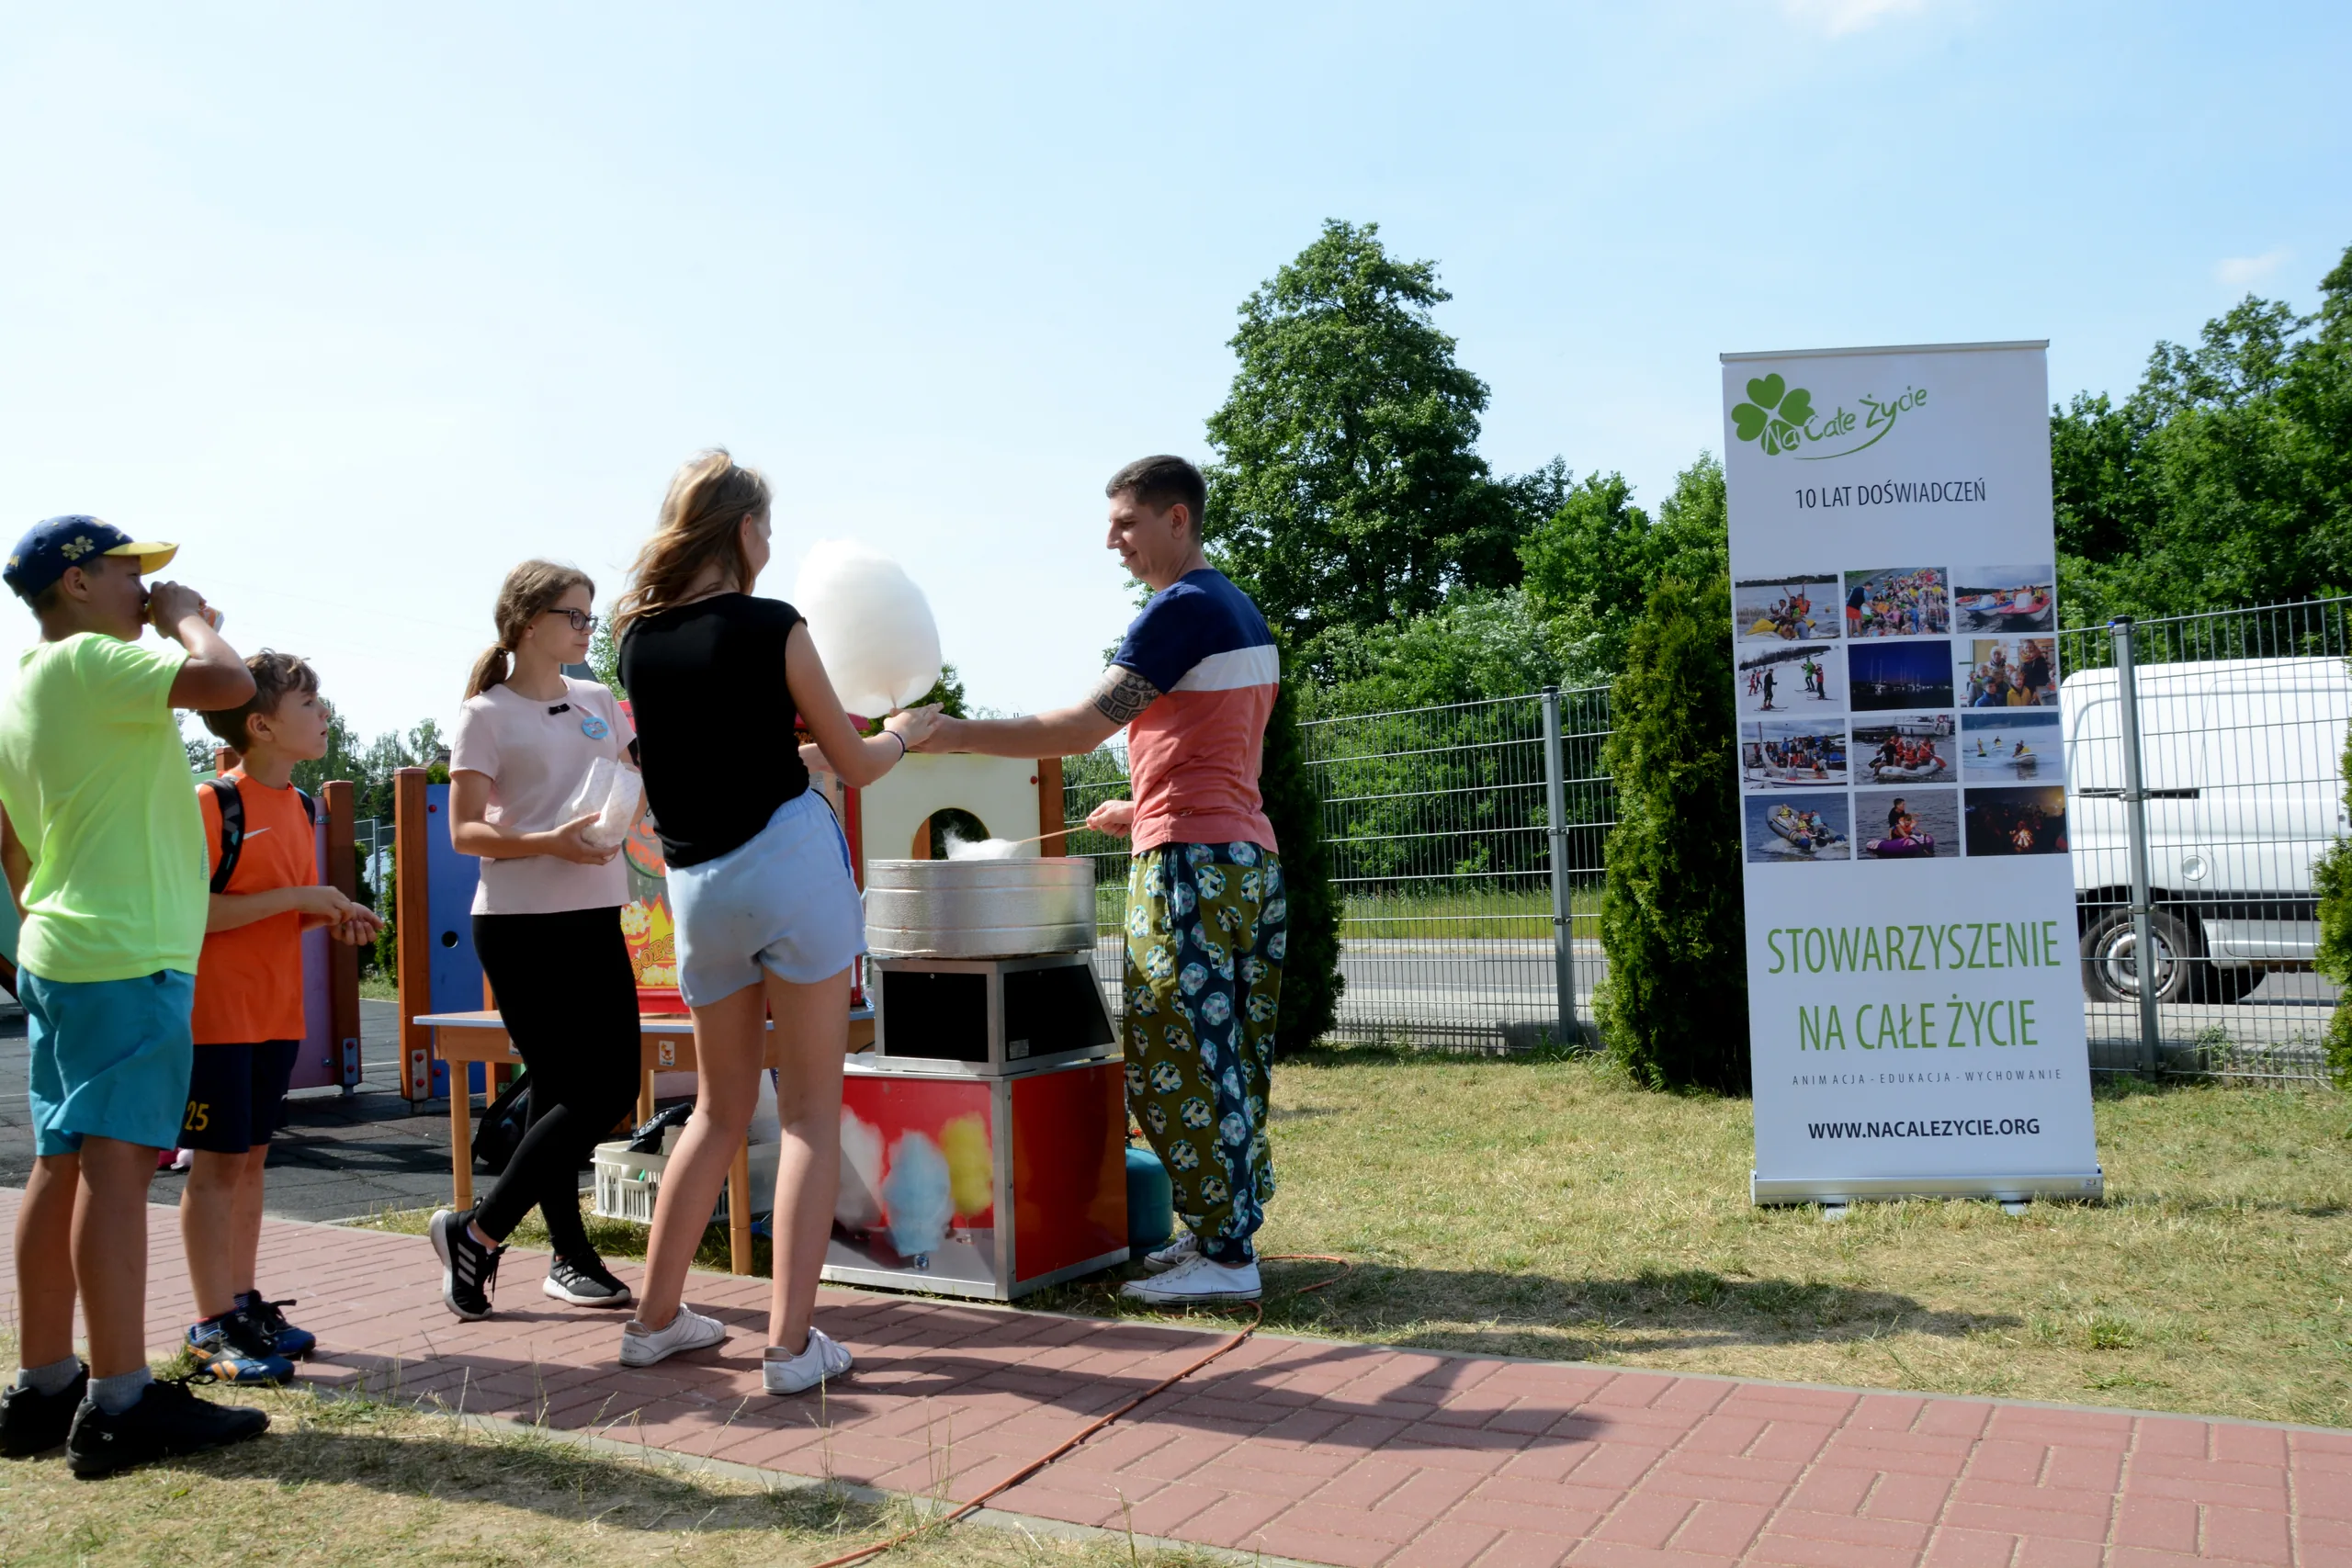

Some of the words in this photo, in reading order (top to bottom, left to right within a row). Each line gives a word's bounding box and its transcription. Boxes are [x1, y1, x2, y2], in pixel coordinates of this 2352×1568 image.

[1763, 423, 1801, 455] Na
[1794, 488, 1817, 509] 10
[1822, 486, 1852, 508] LAT
[1857, 477, 1986, 506] DOŚWIADCZEŃ
[1767, 920, 2062, 975] STOWARZYSZENIE
[1798, 1004, 1847, 1051] NA
[1855, 1002, 1939, 1051] CAŁE
[1945, 992, 2039, 1048] ŻYCIE
[1792, 1074, 1866, 1086] ANIMACJA
[1880, 1071, 1951, 1084] EDUKACJA
[1964, 1068, 2062, 1082] WYCHOWANIE
[185, 1100, 209, 1131] 25
[1807, 1118, 2041, 1140] WWW.NACALEZYCIE.ORG
